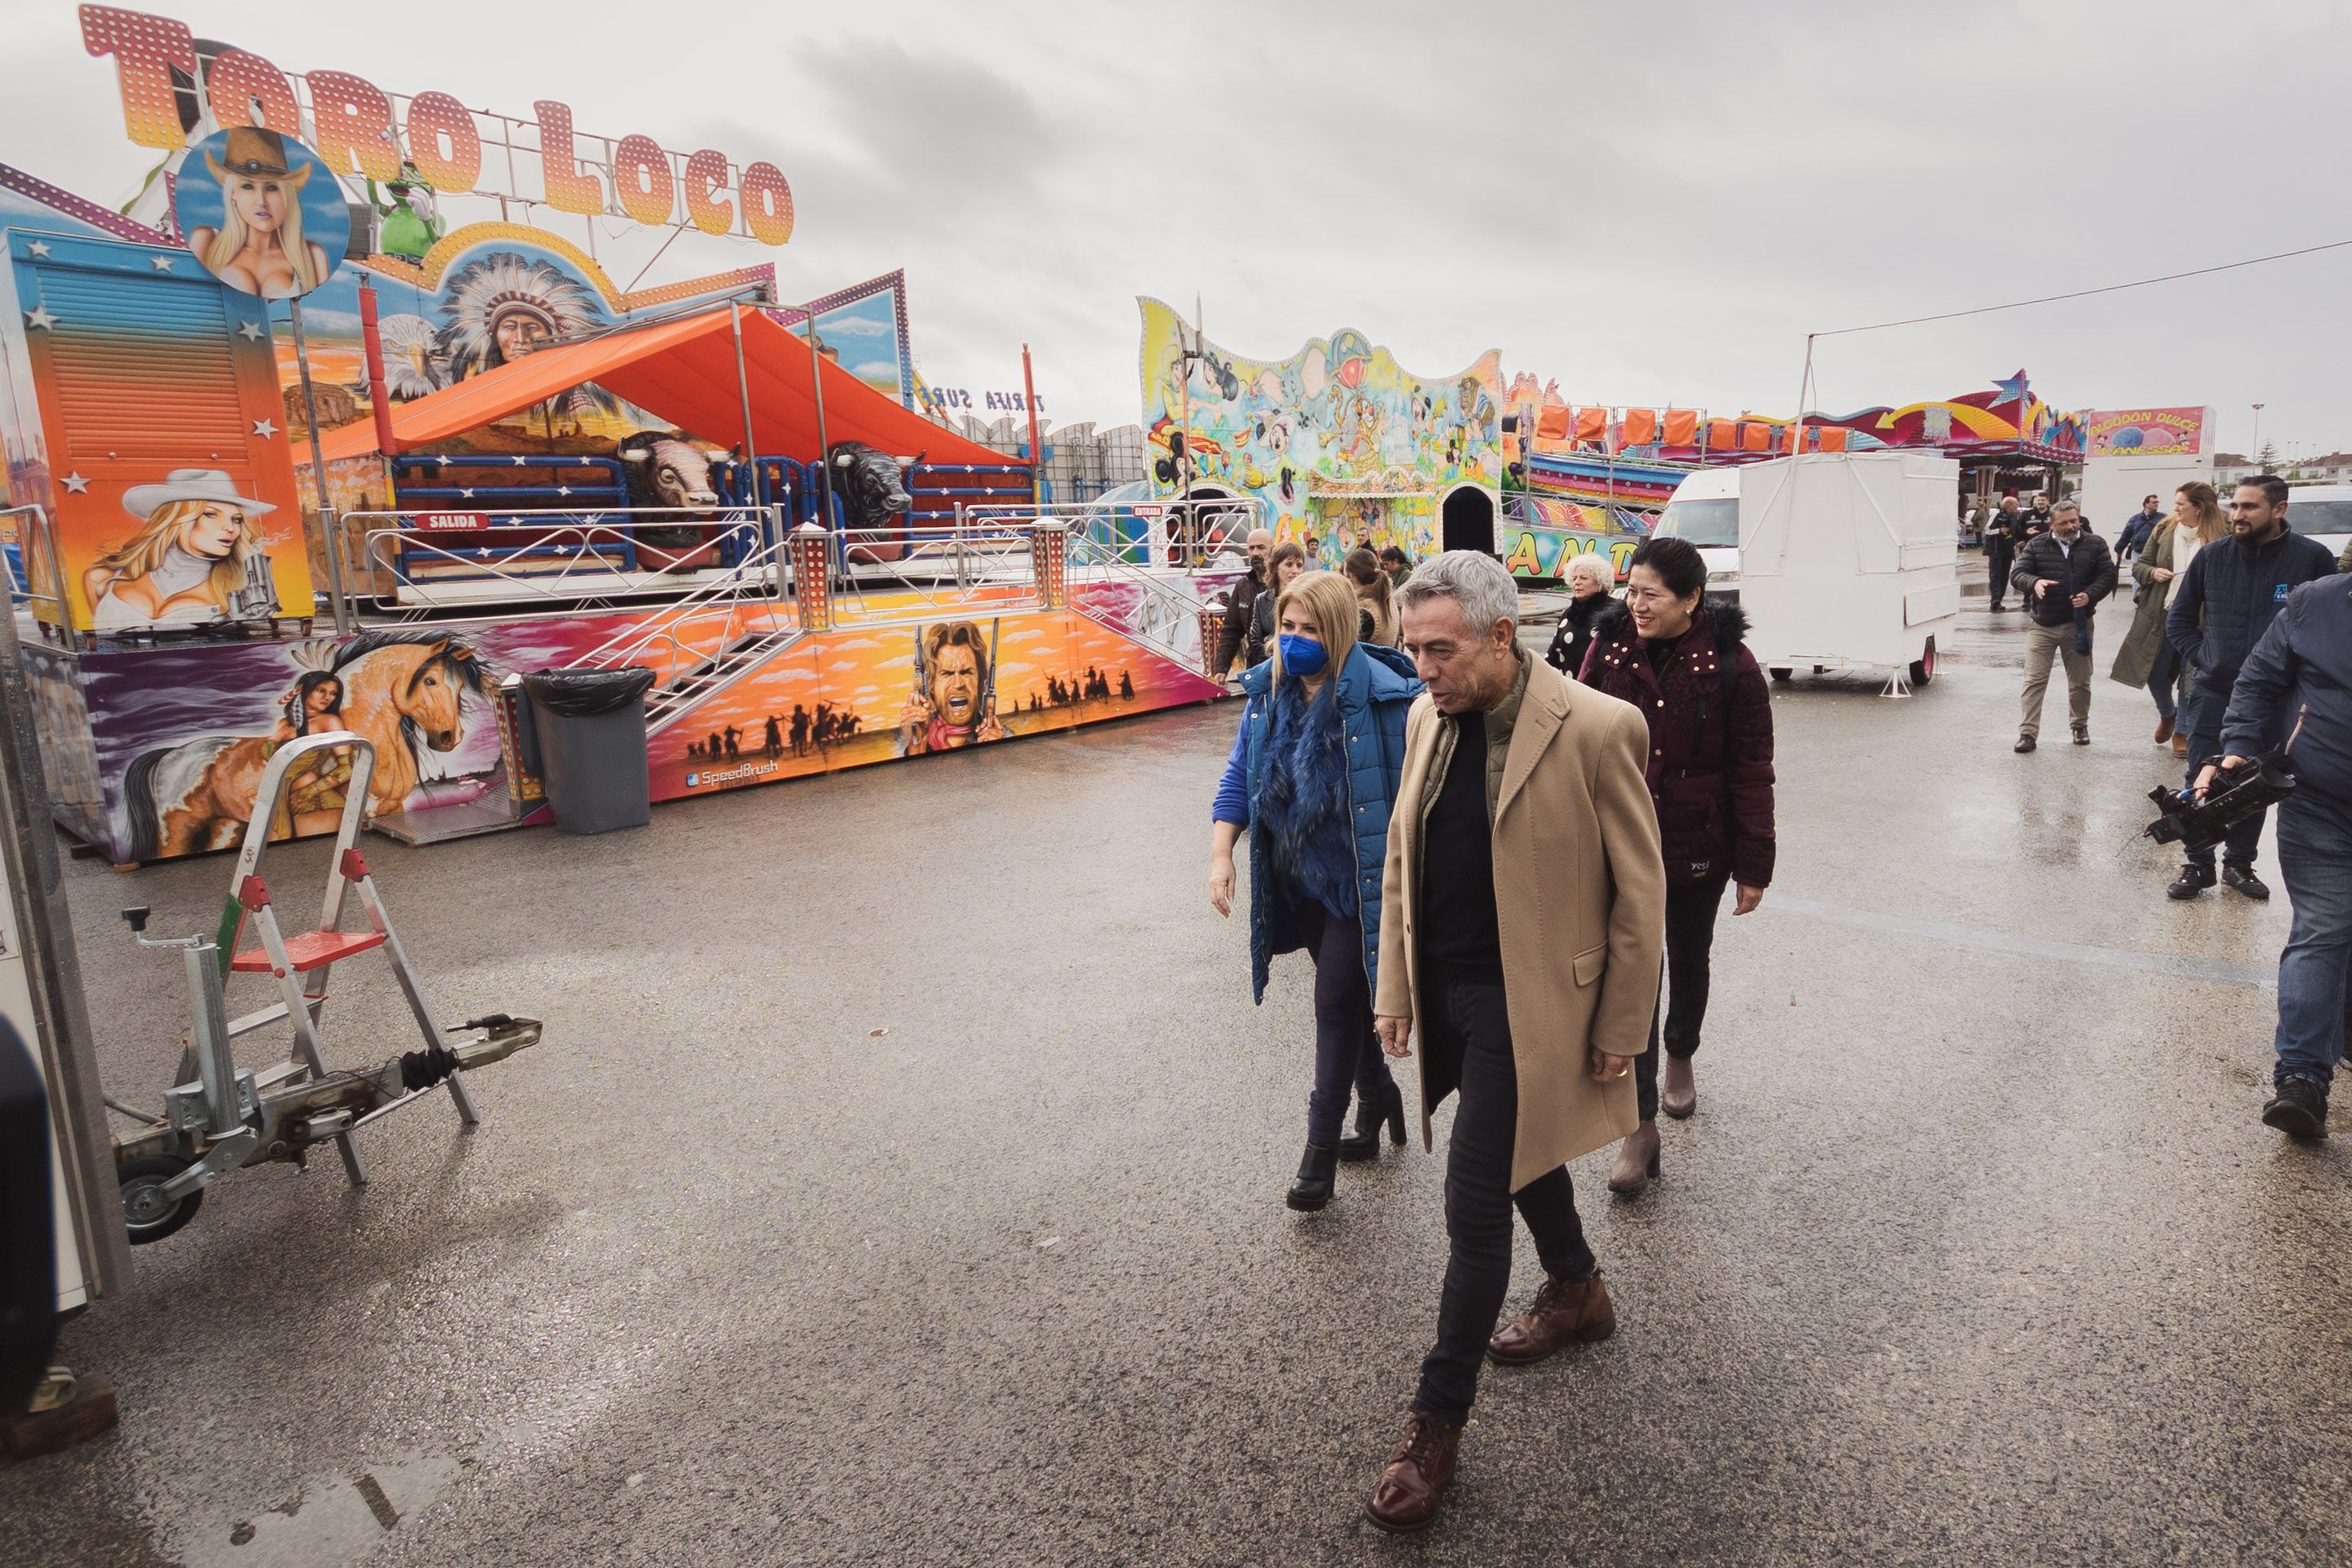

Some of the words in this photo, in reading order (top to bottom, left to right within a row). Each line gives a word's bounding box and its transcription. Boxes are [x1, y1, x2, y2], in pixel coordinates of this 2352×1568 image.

[78, 3, 482, 193] TORO
[534, 99, 794, 246] LOCO
[2156, 413, 2200, 432] DULCE
[429, 515, 477, 528] SALIDA
[701, 759, 779, 787] SpeedBrush
